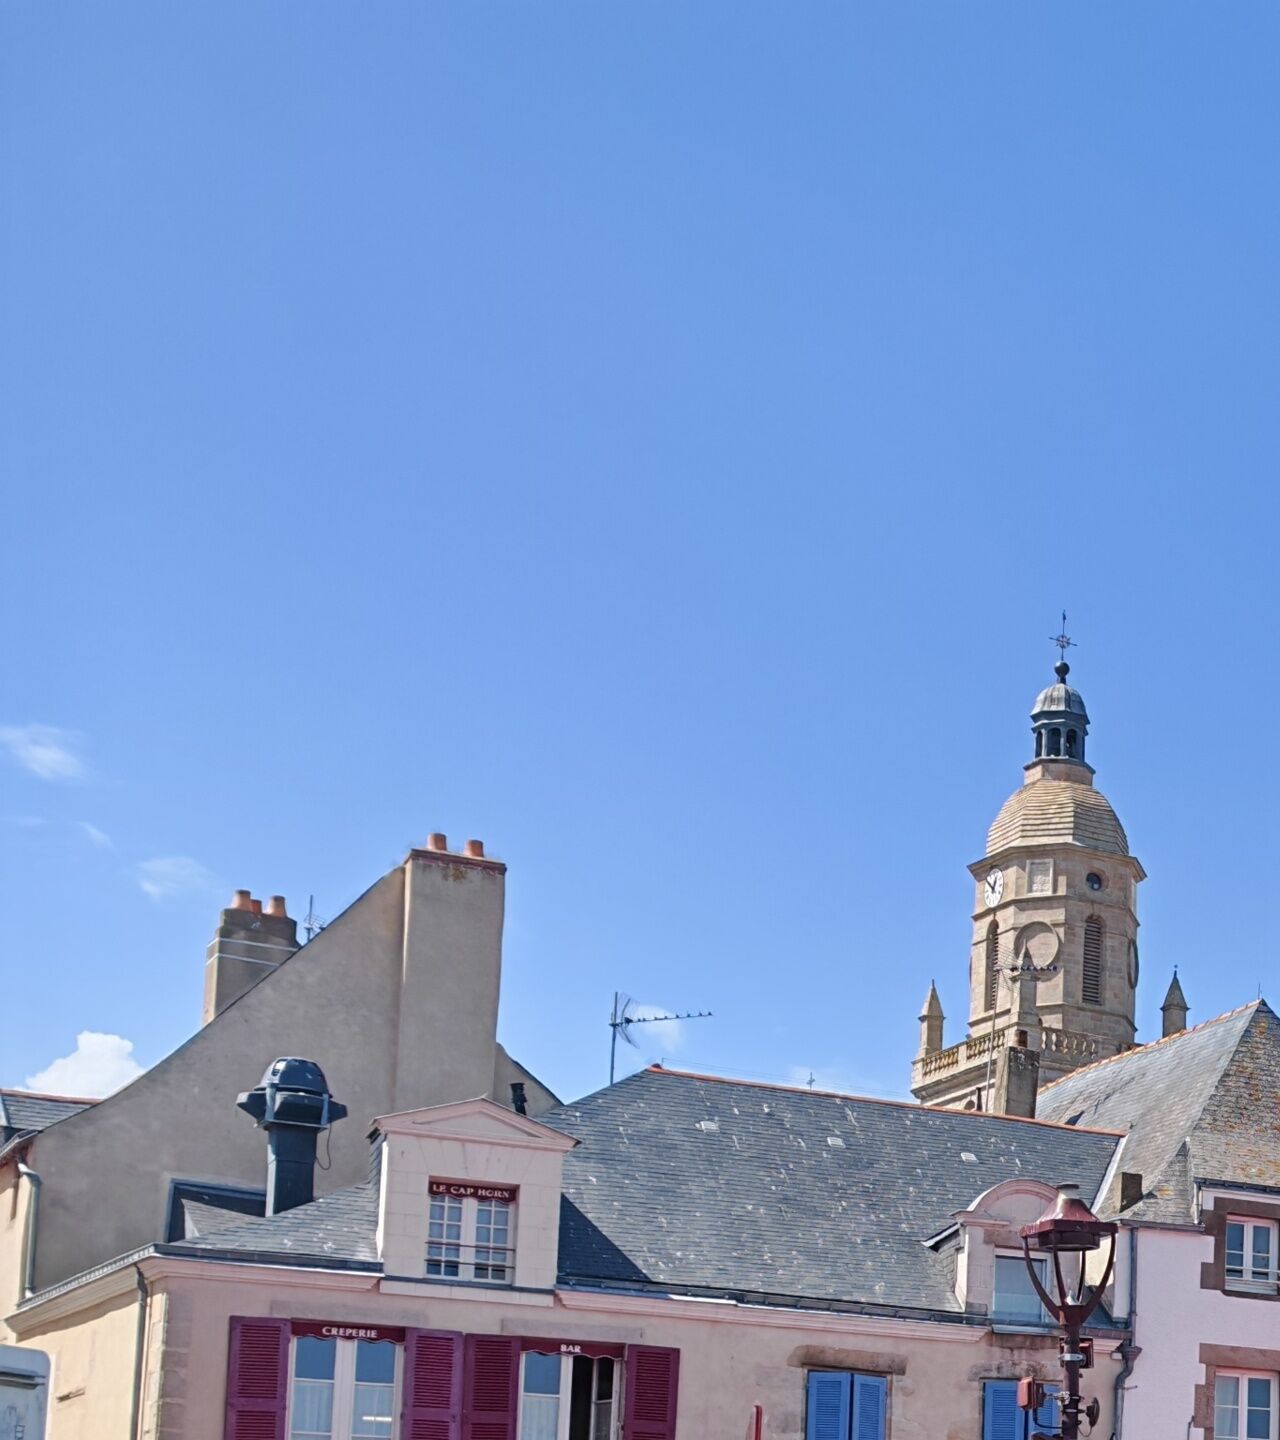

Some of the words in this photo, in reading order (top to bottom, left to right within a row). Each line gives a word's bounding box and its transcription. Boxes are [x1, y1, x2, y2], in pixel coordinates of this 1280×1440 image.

[432, 1184, 447, 1193] LE
[450, 1186, 474, 1195] CAP
[477, 1189, 509, 1198] HORN
[560, 1344, 581, 1353] BAR
